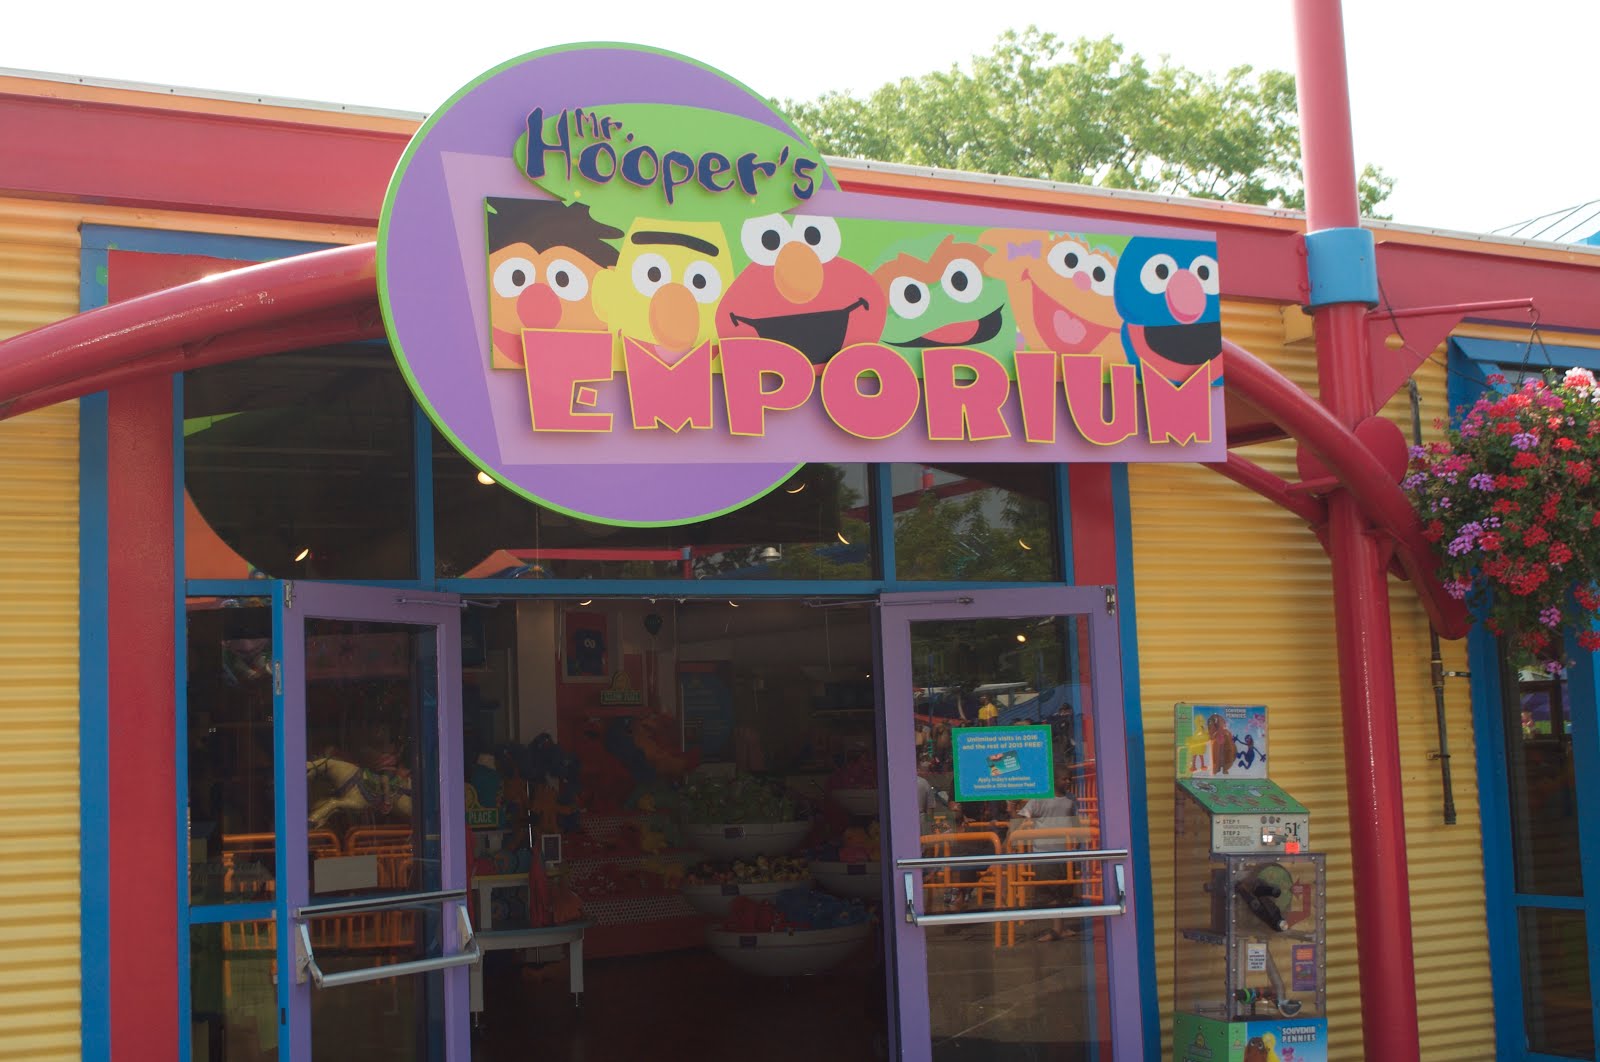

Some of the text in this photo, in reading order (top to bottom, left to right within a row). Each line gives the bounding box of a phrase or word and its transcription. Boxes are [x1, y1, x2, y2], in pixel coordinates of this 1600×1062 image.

[574, 107, 634, 142] Mr.
[525, 106, 819, 206] Hooper's
[520, 327, 1212, 446] EMPORIUM
[966, 735, 997, 743] Unlimited
[469, 810, 493, 824] PLACE
[1281, 1026, 1316, 1035] SOUVENIR
[1281, 1034, 1316, 1043] PENNIES
